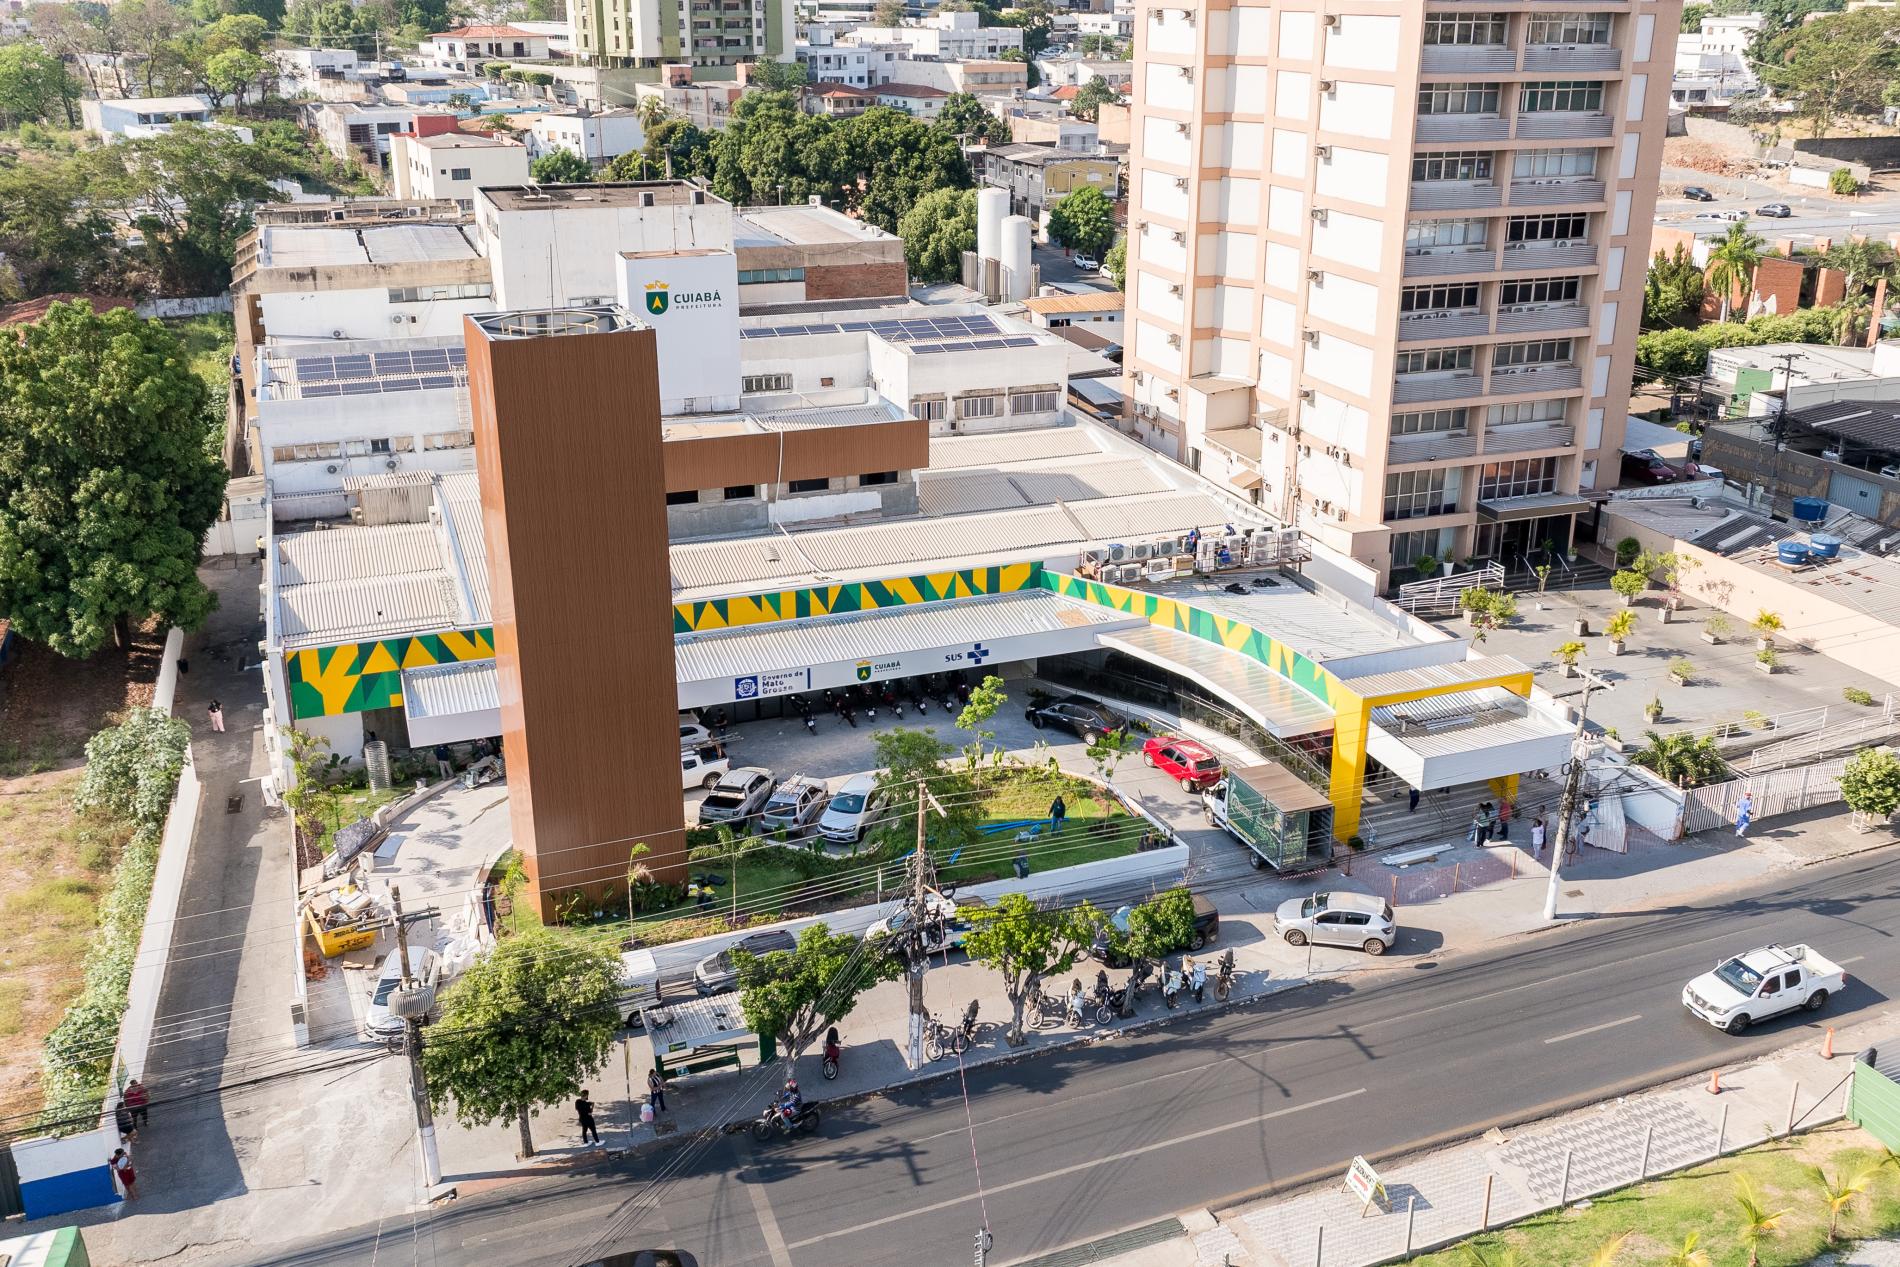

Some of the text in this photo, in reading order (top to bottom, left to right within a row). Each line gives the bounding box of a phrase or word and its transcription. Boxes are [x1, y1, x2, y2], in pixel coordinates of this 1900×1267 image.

[674, 289, 721, 303] CUIABÁ
[945, 652, 962, 662] SUS
[874, 660, 901, 670] CUIABÁ
[762, 673, 793, 681] Governo
[762, 680, 784, 688] Mato
